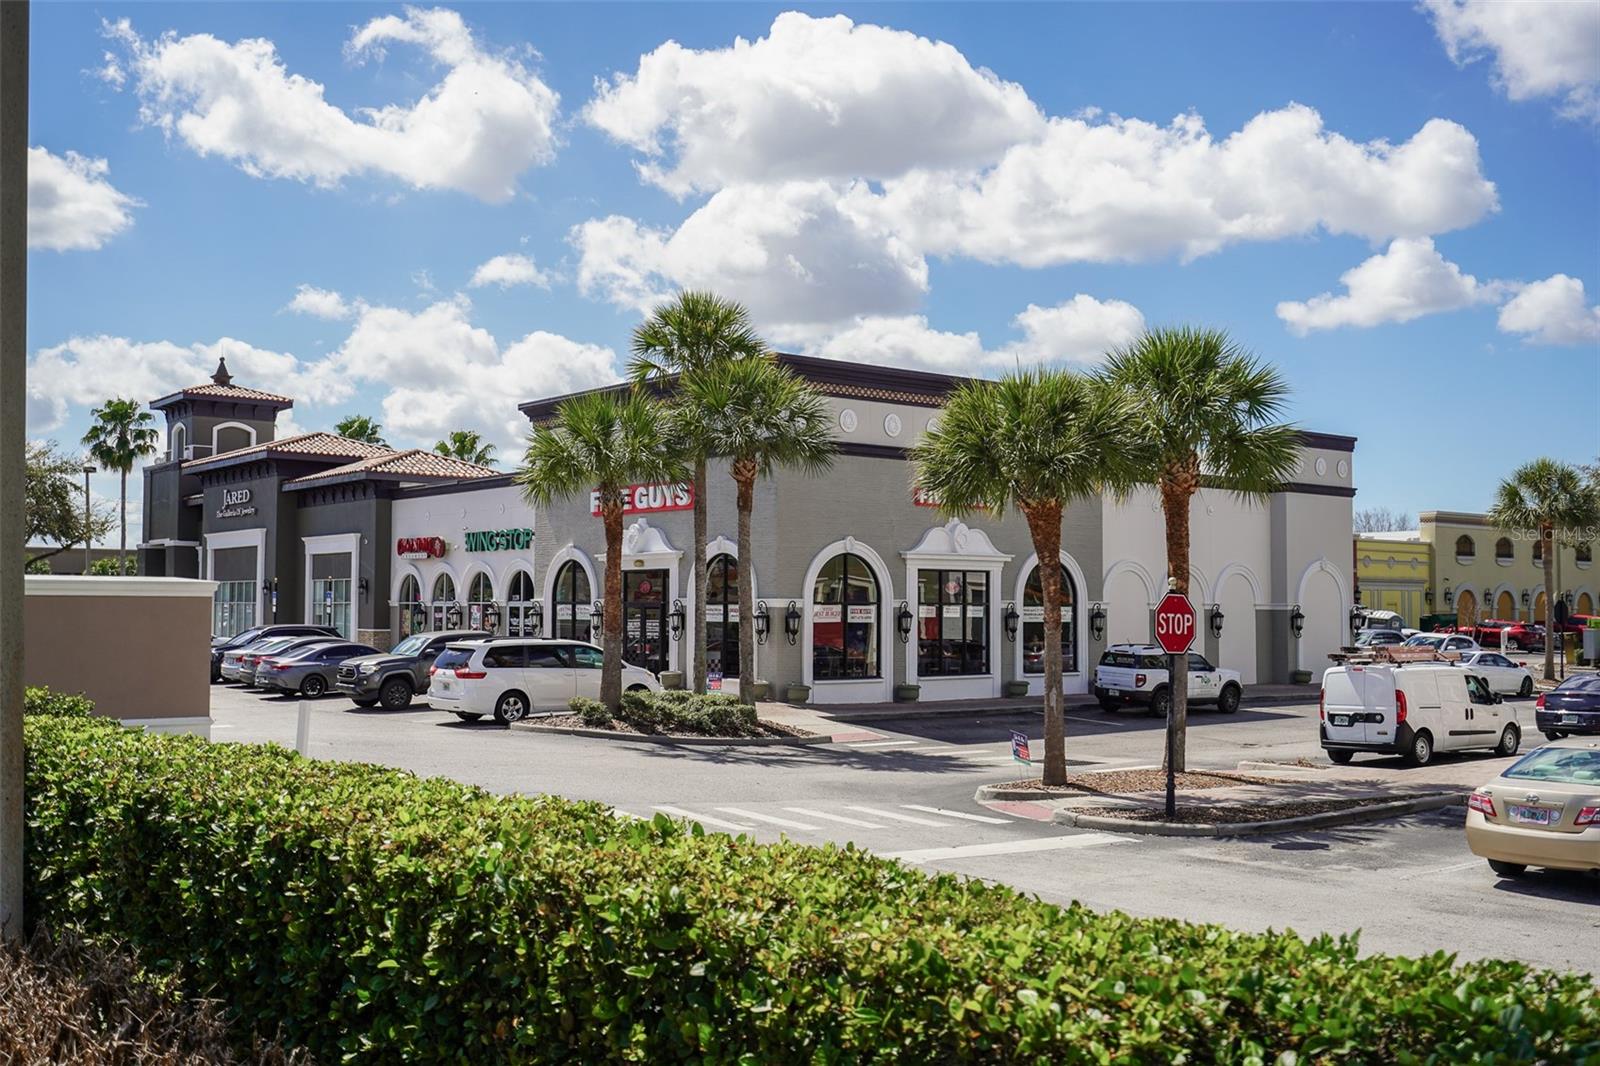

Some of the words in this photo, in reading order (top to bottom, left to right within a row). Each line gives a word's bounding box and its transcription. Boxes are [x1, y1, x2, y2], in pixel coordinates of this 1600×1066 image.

[222, 489, 250, 509] JARED
[590, 487, 632, 513] FE
[634, 482, 692, 510] GUYS
[1158, 613, 1193, 635] STOP
